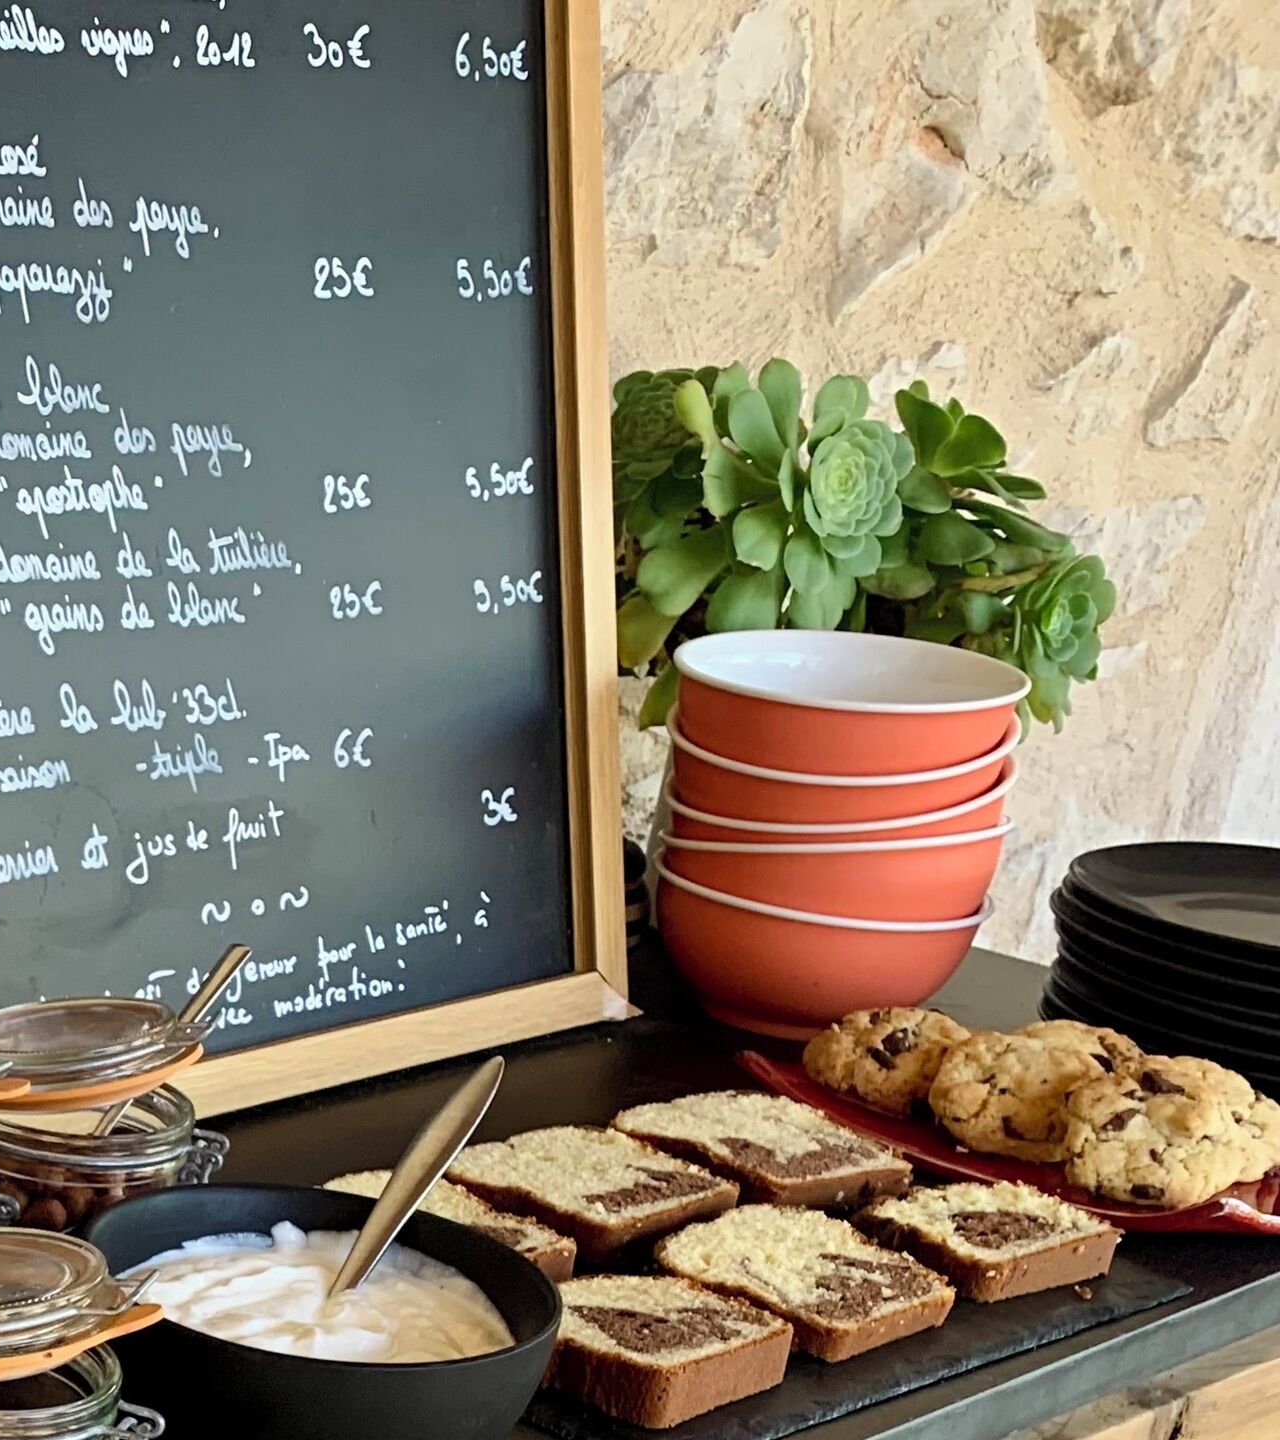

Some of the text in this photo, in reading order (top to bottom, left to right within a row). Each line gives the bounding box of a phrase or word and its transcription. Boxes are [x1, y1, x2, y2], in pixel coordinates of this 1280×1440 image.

[196, 25, 255, 67] 2012
[303, 23, 371, 68] 30€
[455, 32, 528, 82] 6,50€
[74, 177, 113, 227] des
[314, 257, 374, 299] 25€
[456, 256, 533, 302] 5,50€
[17, 355, 109, 415] blanc
[114, 408, 156, 454] des
[324, 474, 371, 513] 25€
[465, 457, 533, 501] 5,50€
[117, 531, 152, 578] de
[166, 528, 200, 574] la
[121, 583, 154, 629] de
[330, 581, 383, 619] 25€
[474, 571, 543, 614] 5,50€
[60, 682, 97, 733] la
[334, 727, 374, 769] 6€
[482, 787, 517, 825] 3€
[81, 823, 109, 869] et
[126, 832, 177, 884] jus
[187, 821, 209, 849] de
[223, 801, 284, 869] fruit
[318, 935, 356, 982] pour
[365, 924, 385, 953] la
[474, 890, 491, 928] à
